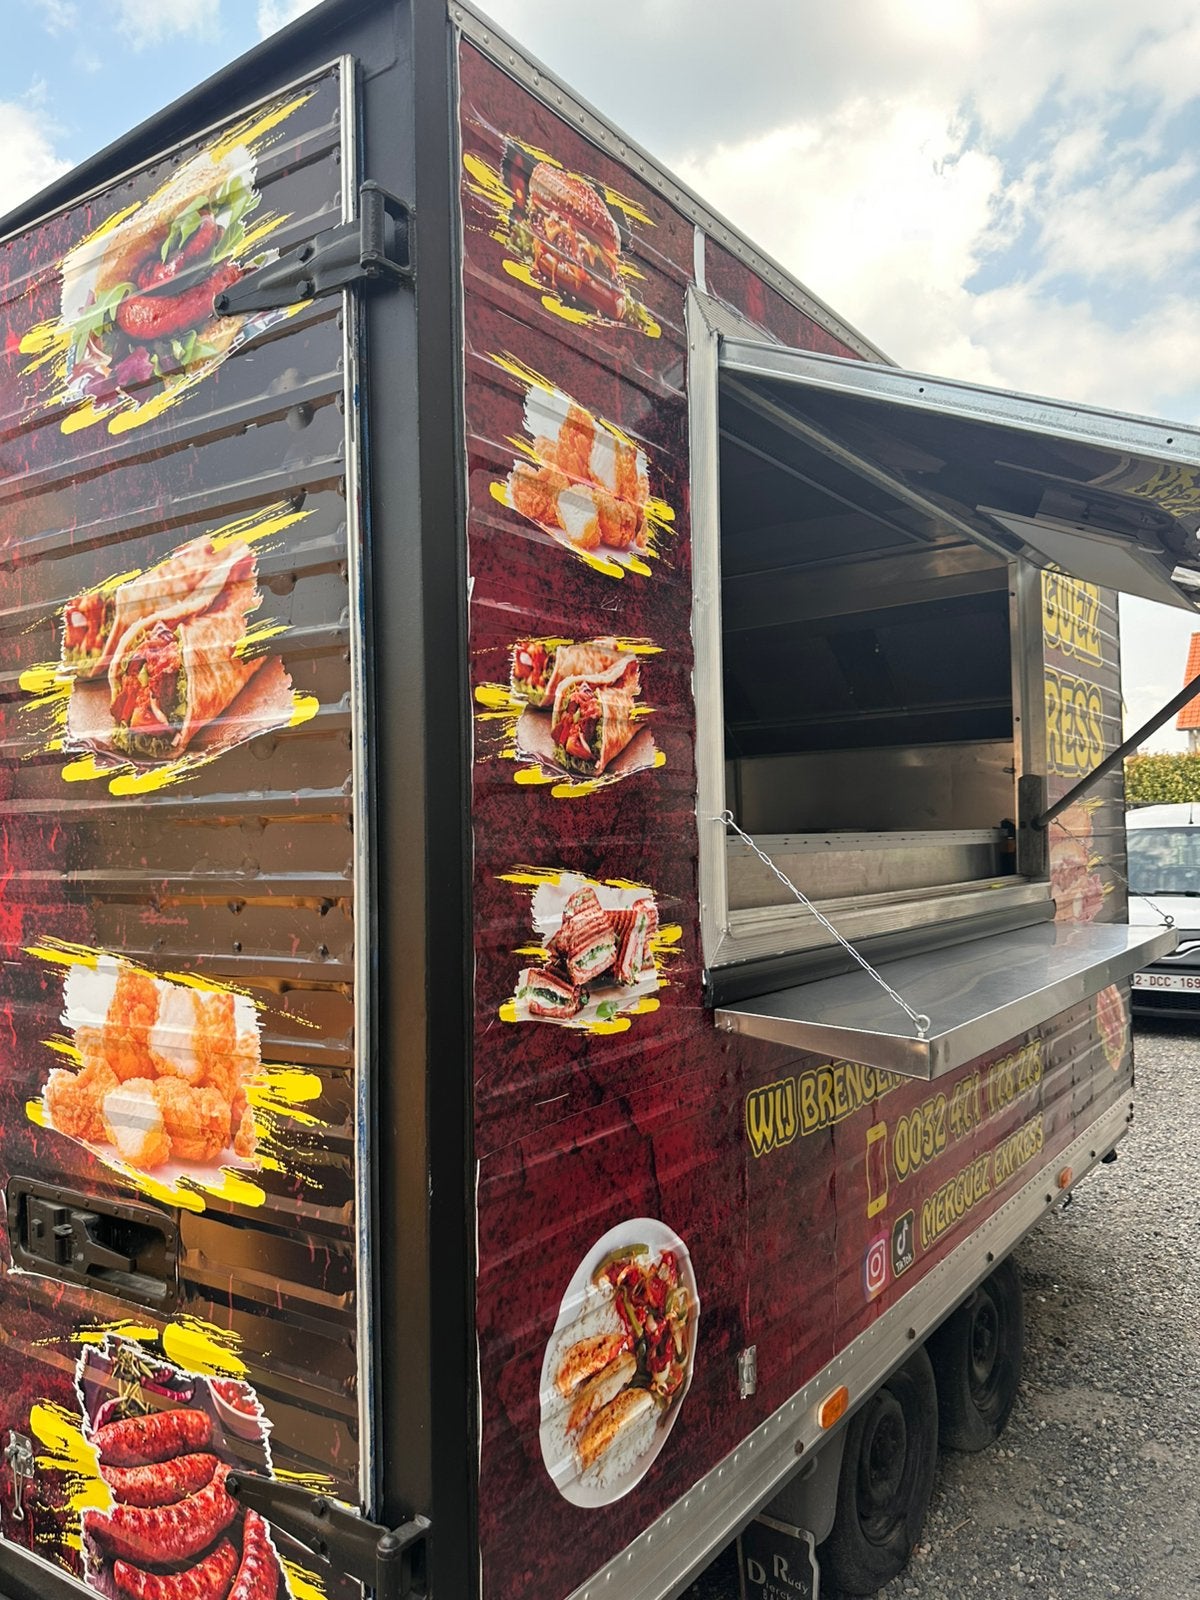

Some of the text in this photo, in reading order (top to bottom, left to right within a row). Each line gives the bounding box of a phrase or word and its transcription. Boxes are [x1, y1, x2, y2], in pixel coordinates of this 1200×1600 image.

[746, 1077, 798, 1157] WIJ
[893, 1091, 947, 1182] 0032
[921, 1111, 1044, 1250] MERGUEZ EXPRESS
